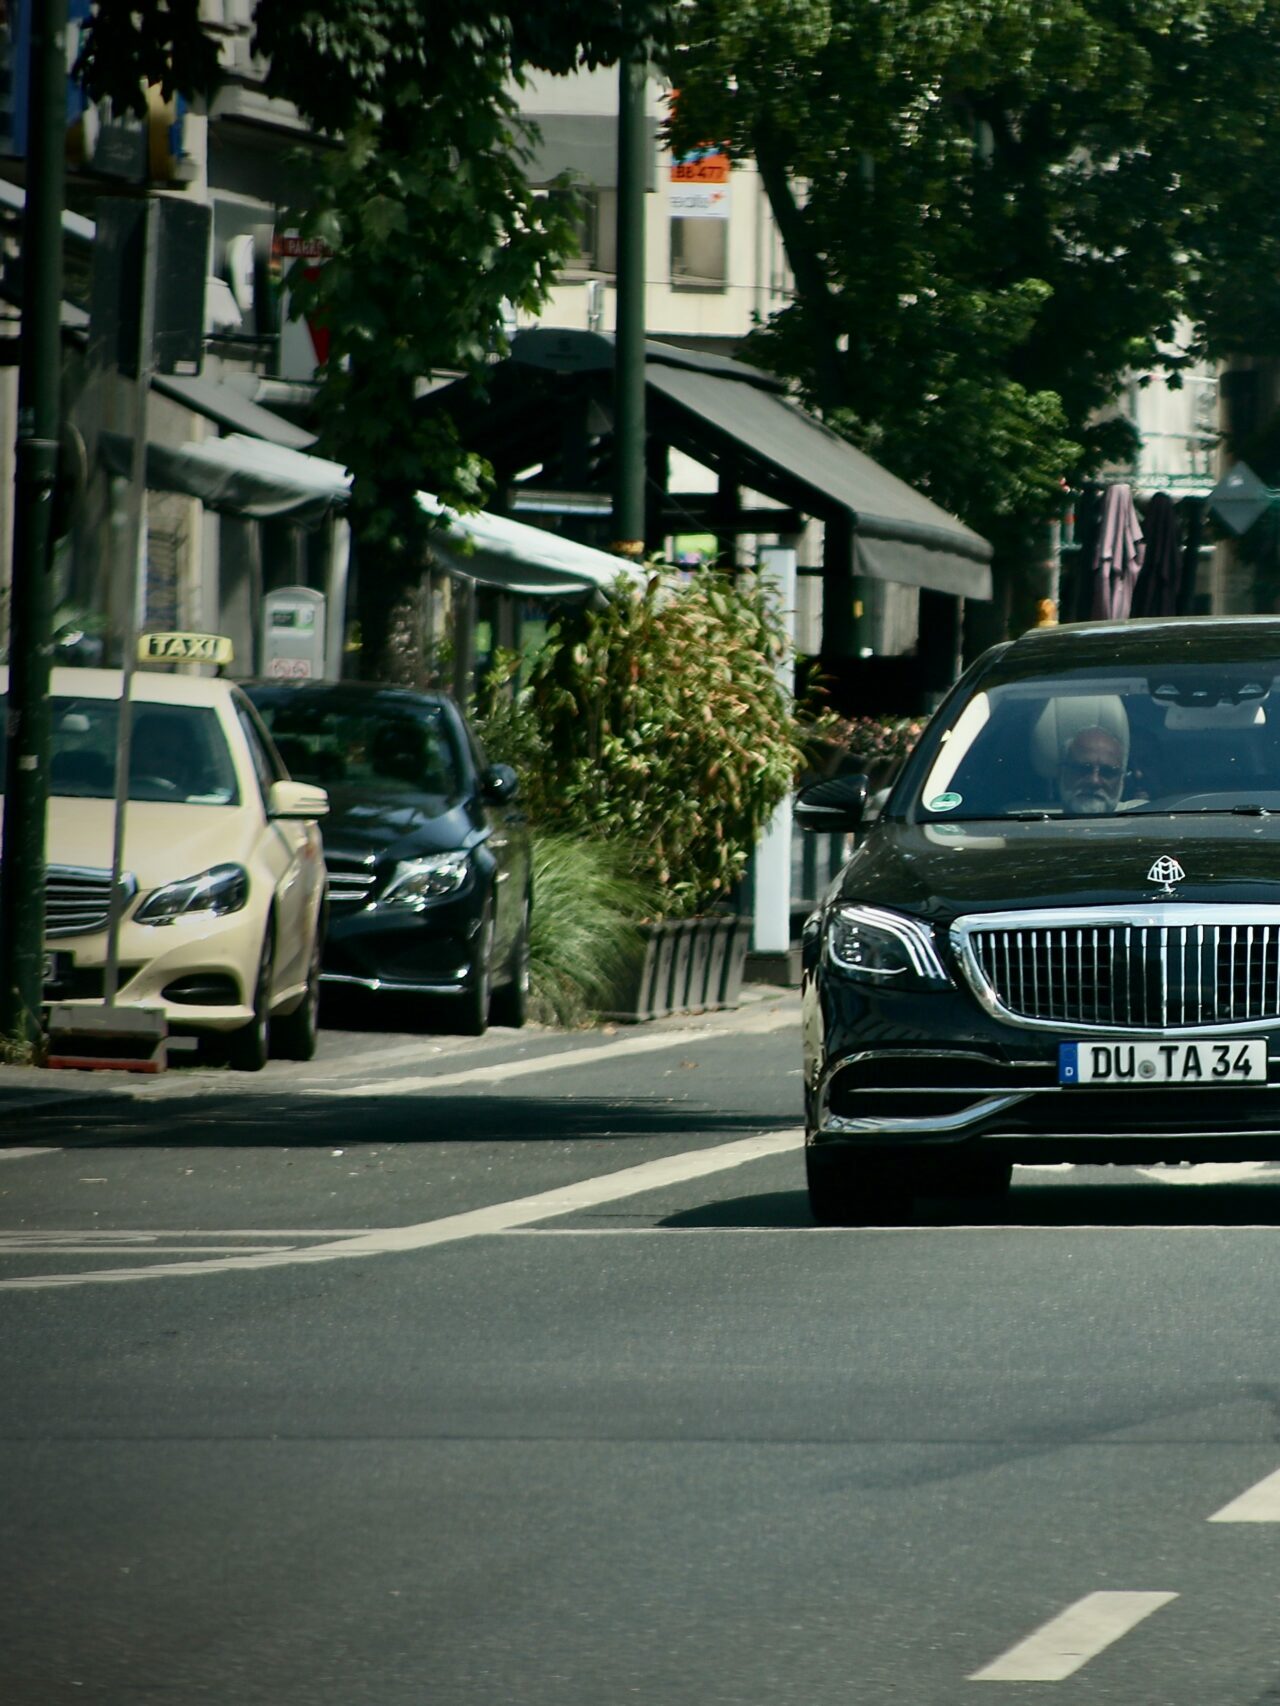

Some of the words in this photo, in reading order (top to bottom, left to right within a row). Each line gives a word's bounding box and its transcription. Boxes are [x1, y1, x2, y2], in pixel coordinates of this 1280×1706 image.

[148, 637, 217, 657] TAXI
[1065, 1066, 1074, 1076] D
[1091, 1045, 1136, 1079] DU
[1158, 1045, 1203, 1078] TA
[1211, 1044, 1252, 1077] 34
